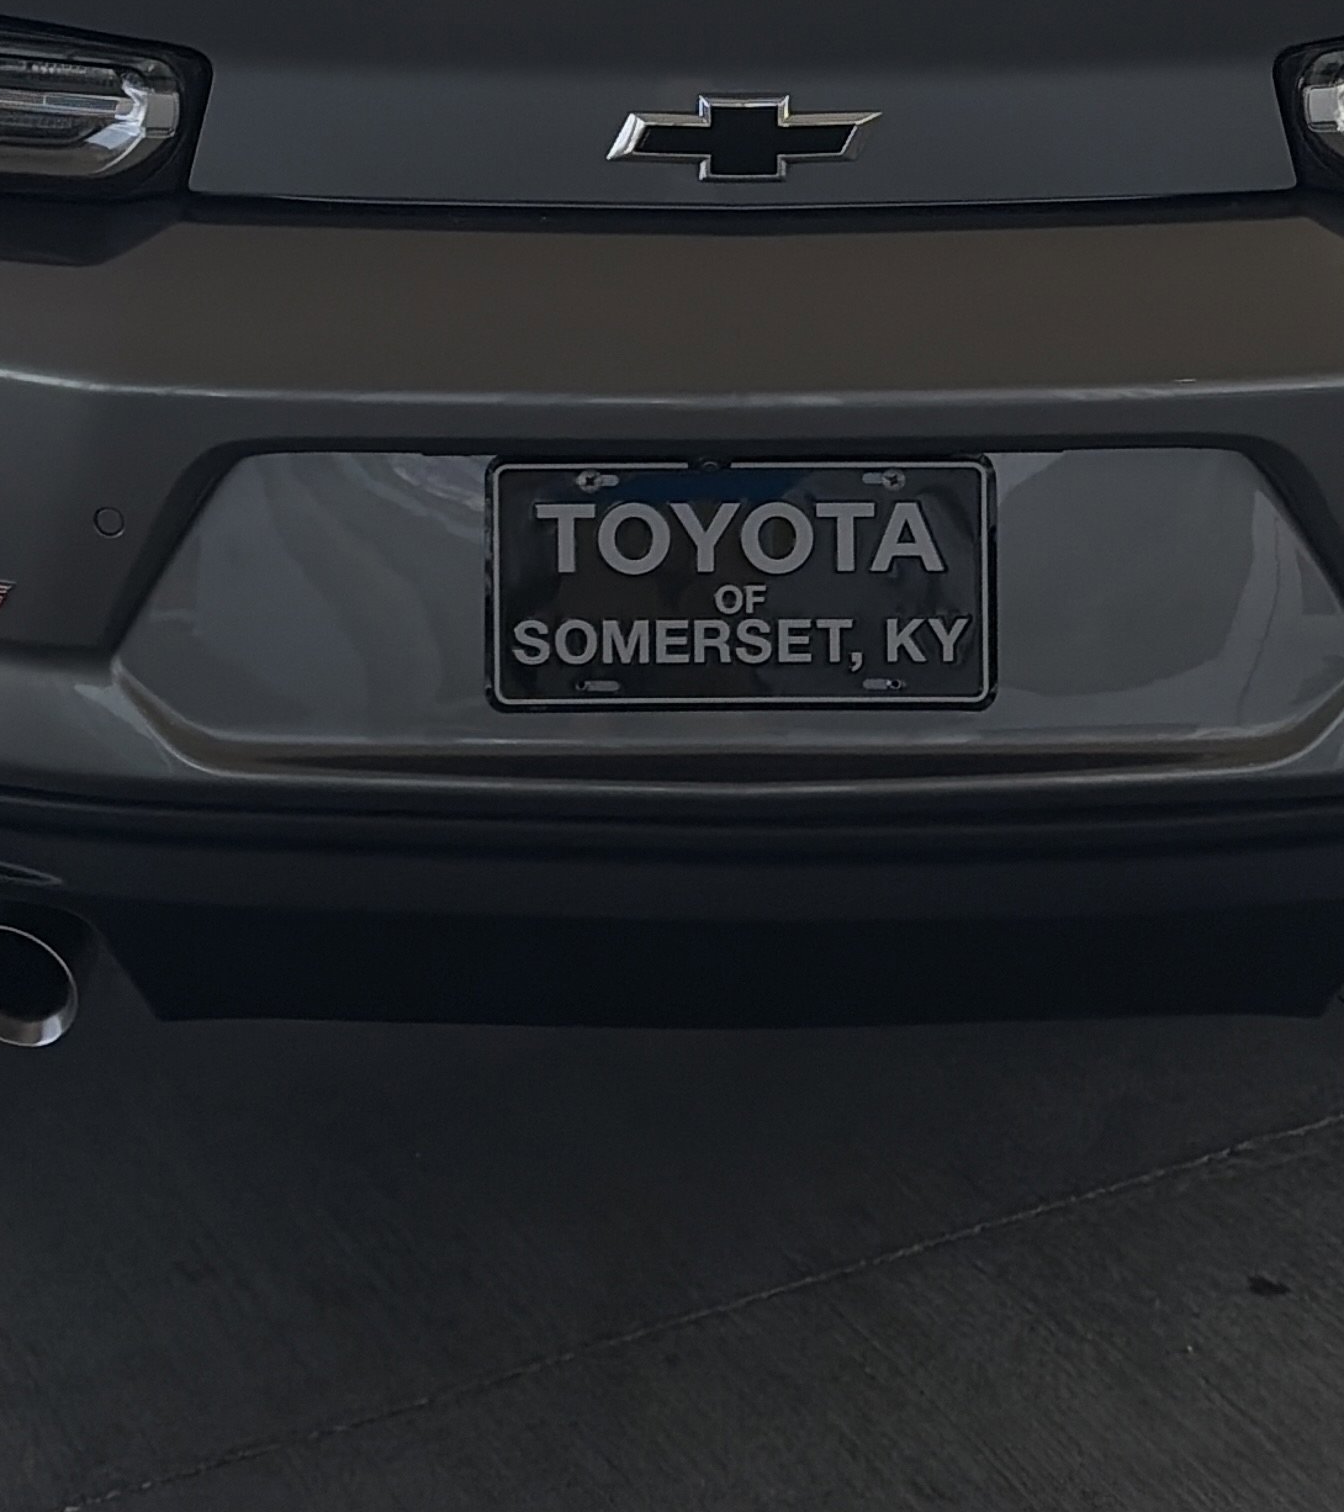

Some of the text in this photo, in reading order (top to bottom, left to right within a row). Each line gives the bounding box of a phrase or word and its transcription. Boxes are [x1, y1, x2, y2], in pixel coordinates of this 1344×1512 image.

[535, 501, 945, 575] TOYOTA
[714, 584, 767, 615] OF
[513, 616, 971, 671] SOMERSET, KY
